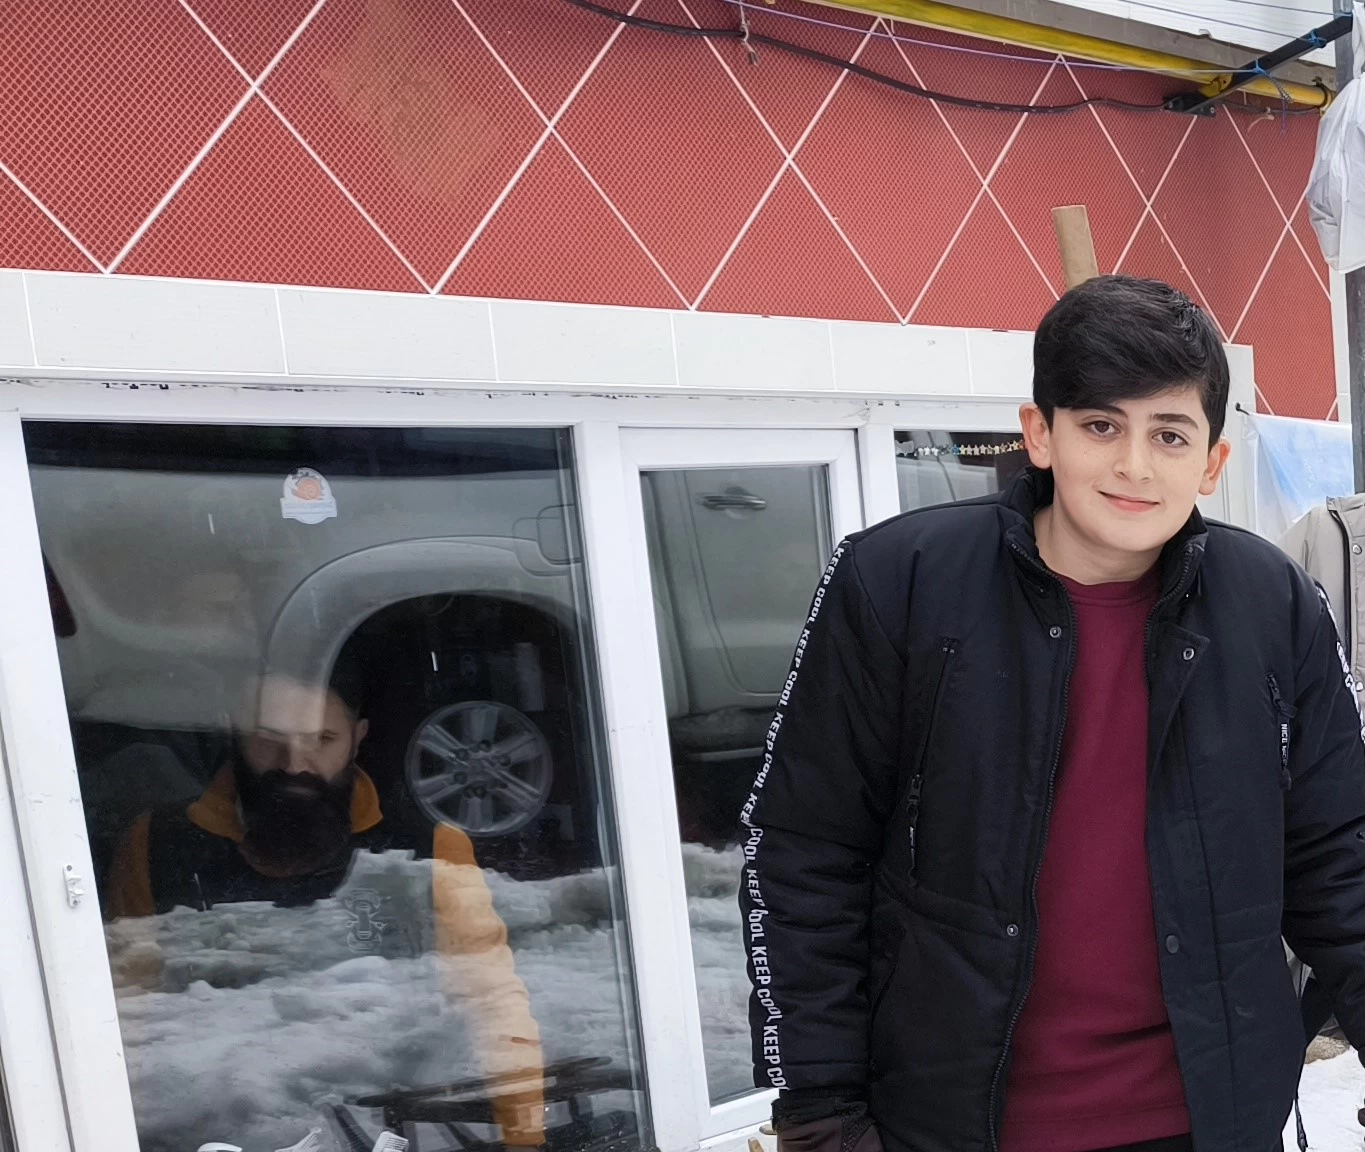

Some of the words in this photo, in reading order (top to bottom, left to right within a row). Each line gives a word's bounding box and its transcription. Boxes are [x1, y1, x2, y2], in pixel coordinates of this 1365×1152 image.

[822, 547, 845, 585] KEEP
[806, 587, 826, 625] COOL
[795, 628, 810, 668] KEEP
[778, 670, 798, 706] COOL
[765, 711, 784, 751] KEEP
[751, 945, 771, 985] KEEP
[756, 988, 783, 1023] COOL
[763, 1025, 781, 1065] KEEP
